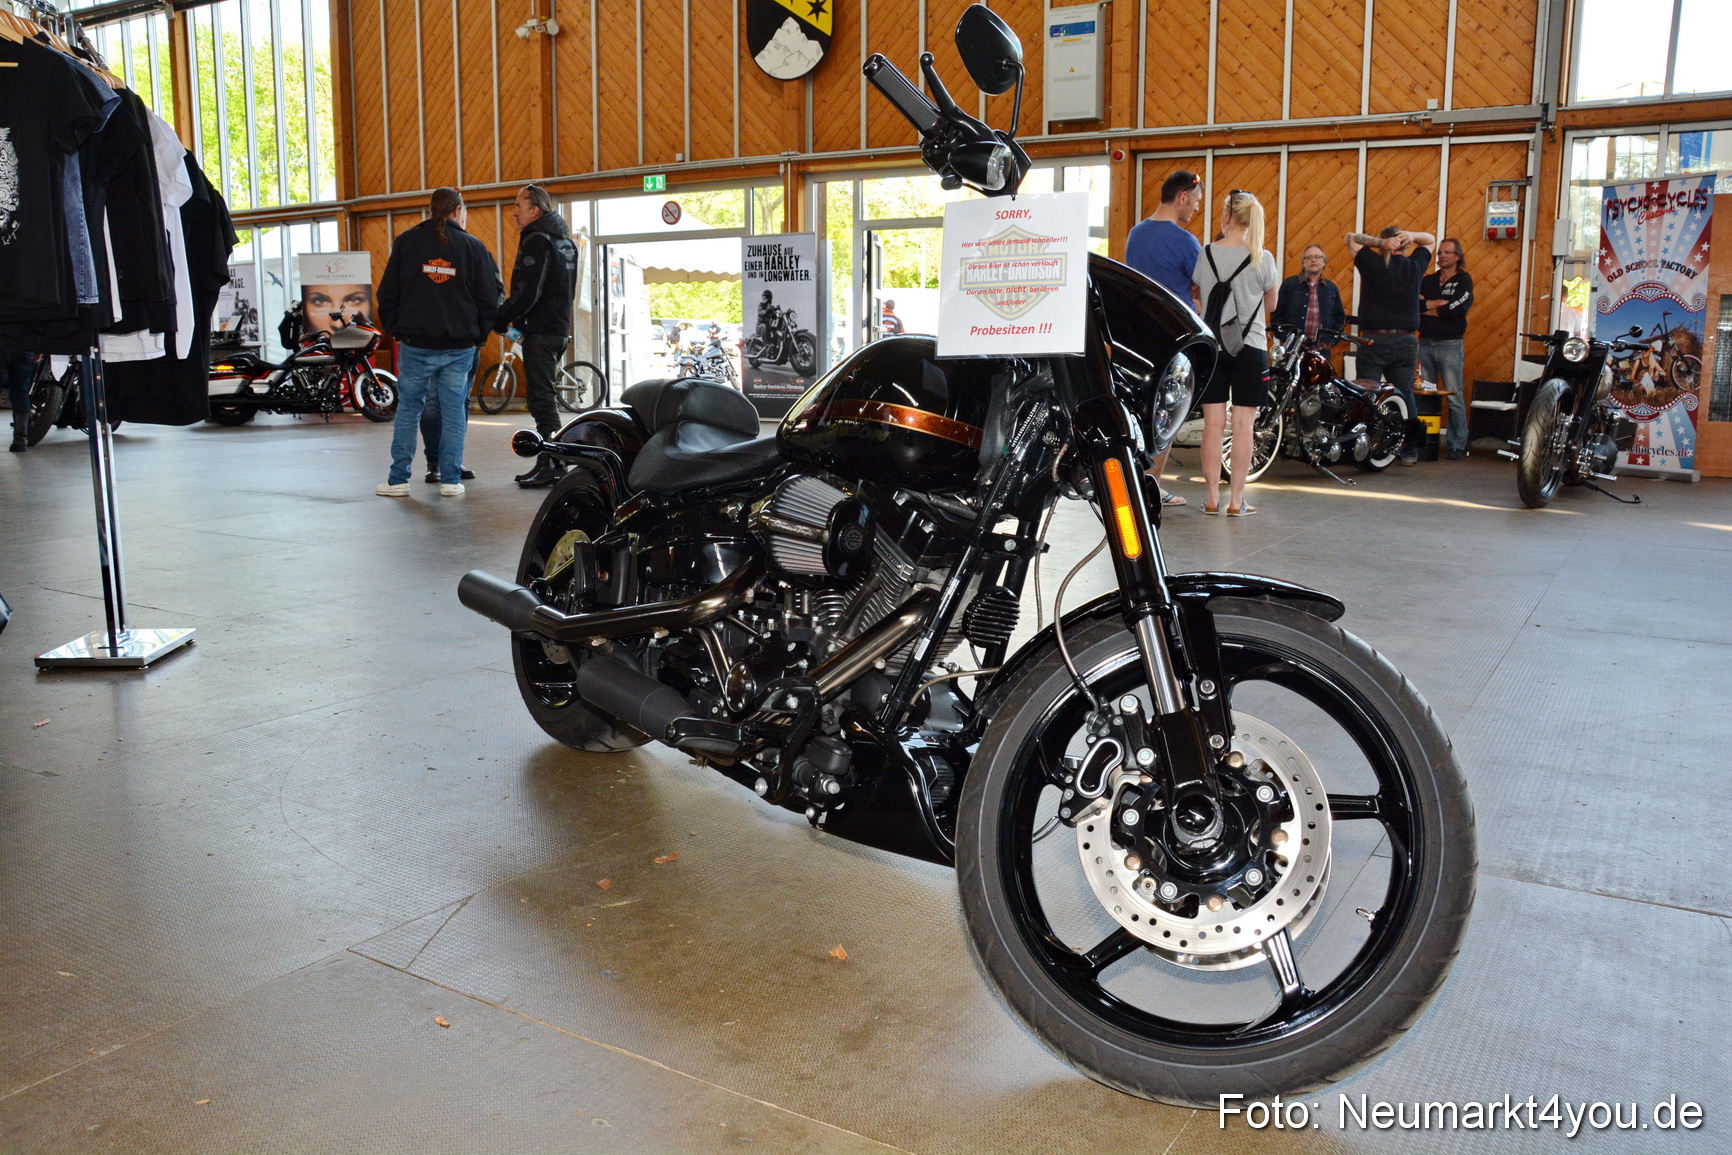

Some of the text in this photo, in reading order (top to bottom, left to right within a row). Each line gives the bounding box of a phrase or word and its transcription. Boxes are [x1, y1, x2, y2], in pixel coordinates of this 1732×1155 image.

[994, 209, 1033, 220] SORRY,
[988, 238, 1005, 246] leider
[1006, 237, 1031, 246] jemand
[1031, 236, 1068, 244] schneller!!!
[747, 244, 793, 257] ZUHAUSE AUF
[744, 255, 800, 271] EINER HARLEY
[988, 261, 1002, 269] Bike
[1011, 260, 1030, 268] schon
[1031, 259, 1059, 268] verkauft
[764, 270, 812, 282] LONGWATER.
[1607, 259, 1699, 283] OLD SCHOOL FACTORY
[966, 284, 1059, 296] Darum bitte nicht berühren
[996, 298, 1027, 307] und/oder
[970, 322, 1053, 336] Probesitzen !!!
